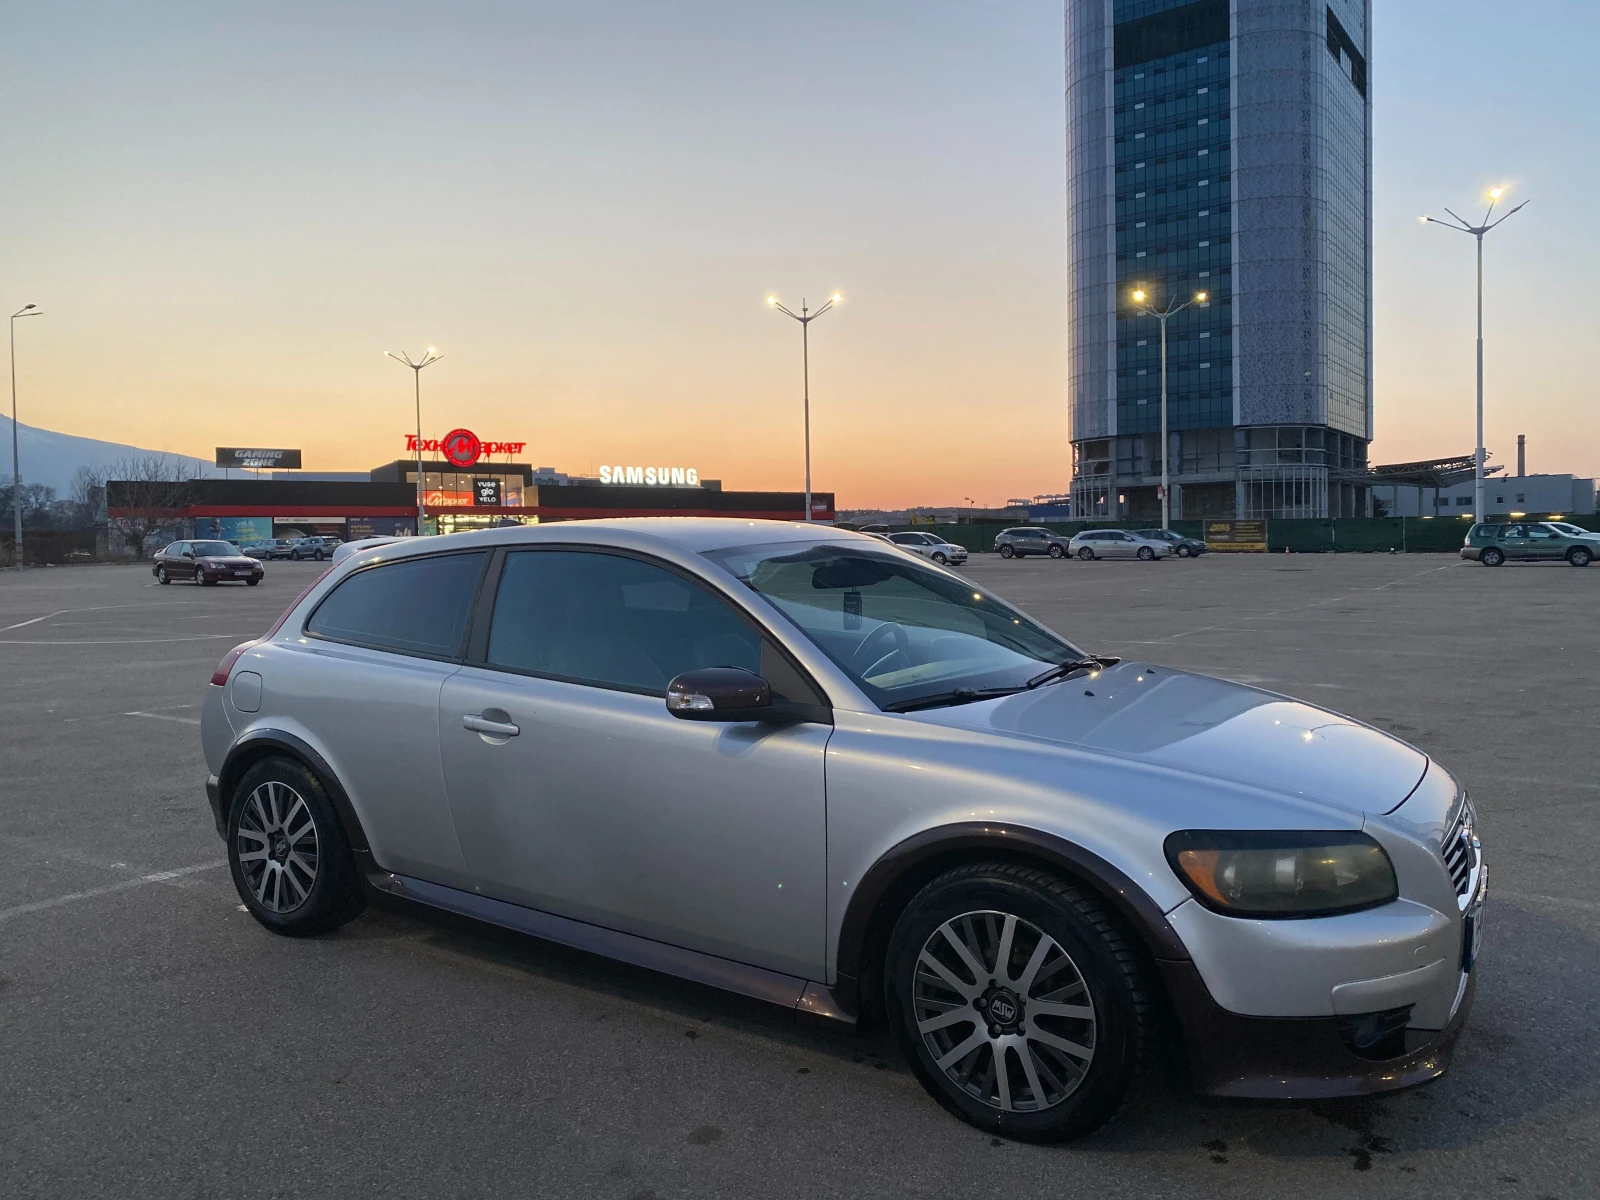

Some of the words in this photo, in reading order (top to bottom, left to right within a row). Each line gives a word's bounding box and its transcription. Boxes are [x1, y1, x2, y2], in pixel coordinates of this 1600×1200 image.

[234, 450, 283, 459] GAMING
[242, 458, 275, 467] ZONE
[599, 465, 698, 485] SAMSUNG
[481, 488, 494, 496] glo
[992, 999, 1014, 1020] MSW
